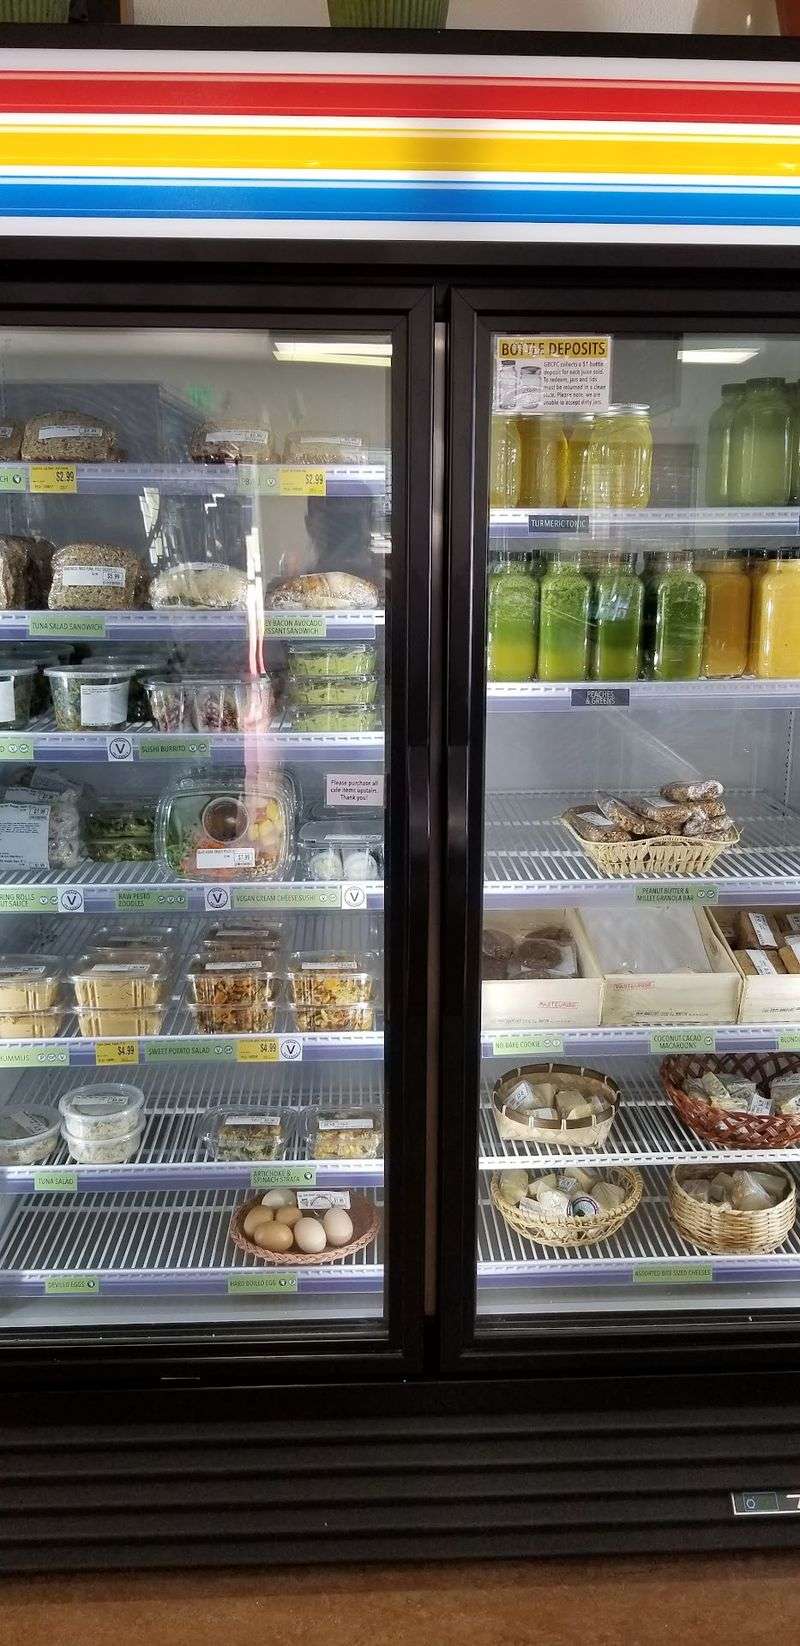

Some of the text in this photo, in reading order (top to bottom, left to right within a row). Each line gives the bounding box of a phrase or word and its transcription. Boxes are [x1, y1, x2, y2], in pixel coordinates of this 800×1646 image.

[501, 341, 606, 356] BOTTLE DEPOSITS
[56, 470, 74, 482] $2.99
[304, 472, 324, 484] $2.99
[566, 520, 586, 528] TONIC
[69, 623, 102, 632] SANDWICH
[141, 744, 186, 753] SUSHI BURRITO
[236, 894, 255, 902] VEGAN
[117, 1045, 135, 1056] $4.99
[148, 1047, 168, 1056] SWEET
[168, 1047, 190, 1055] POTATO
[260, 1042, 277, 1053] $4.99
